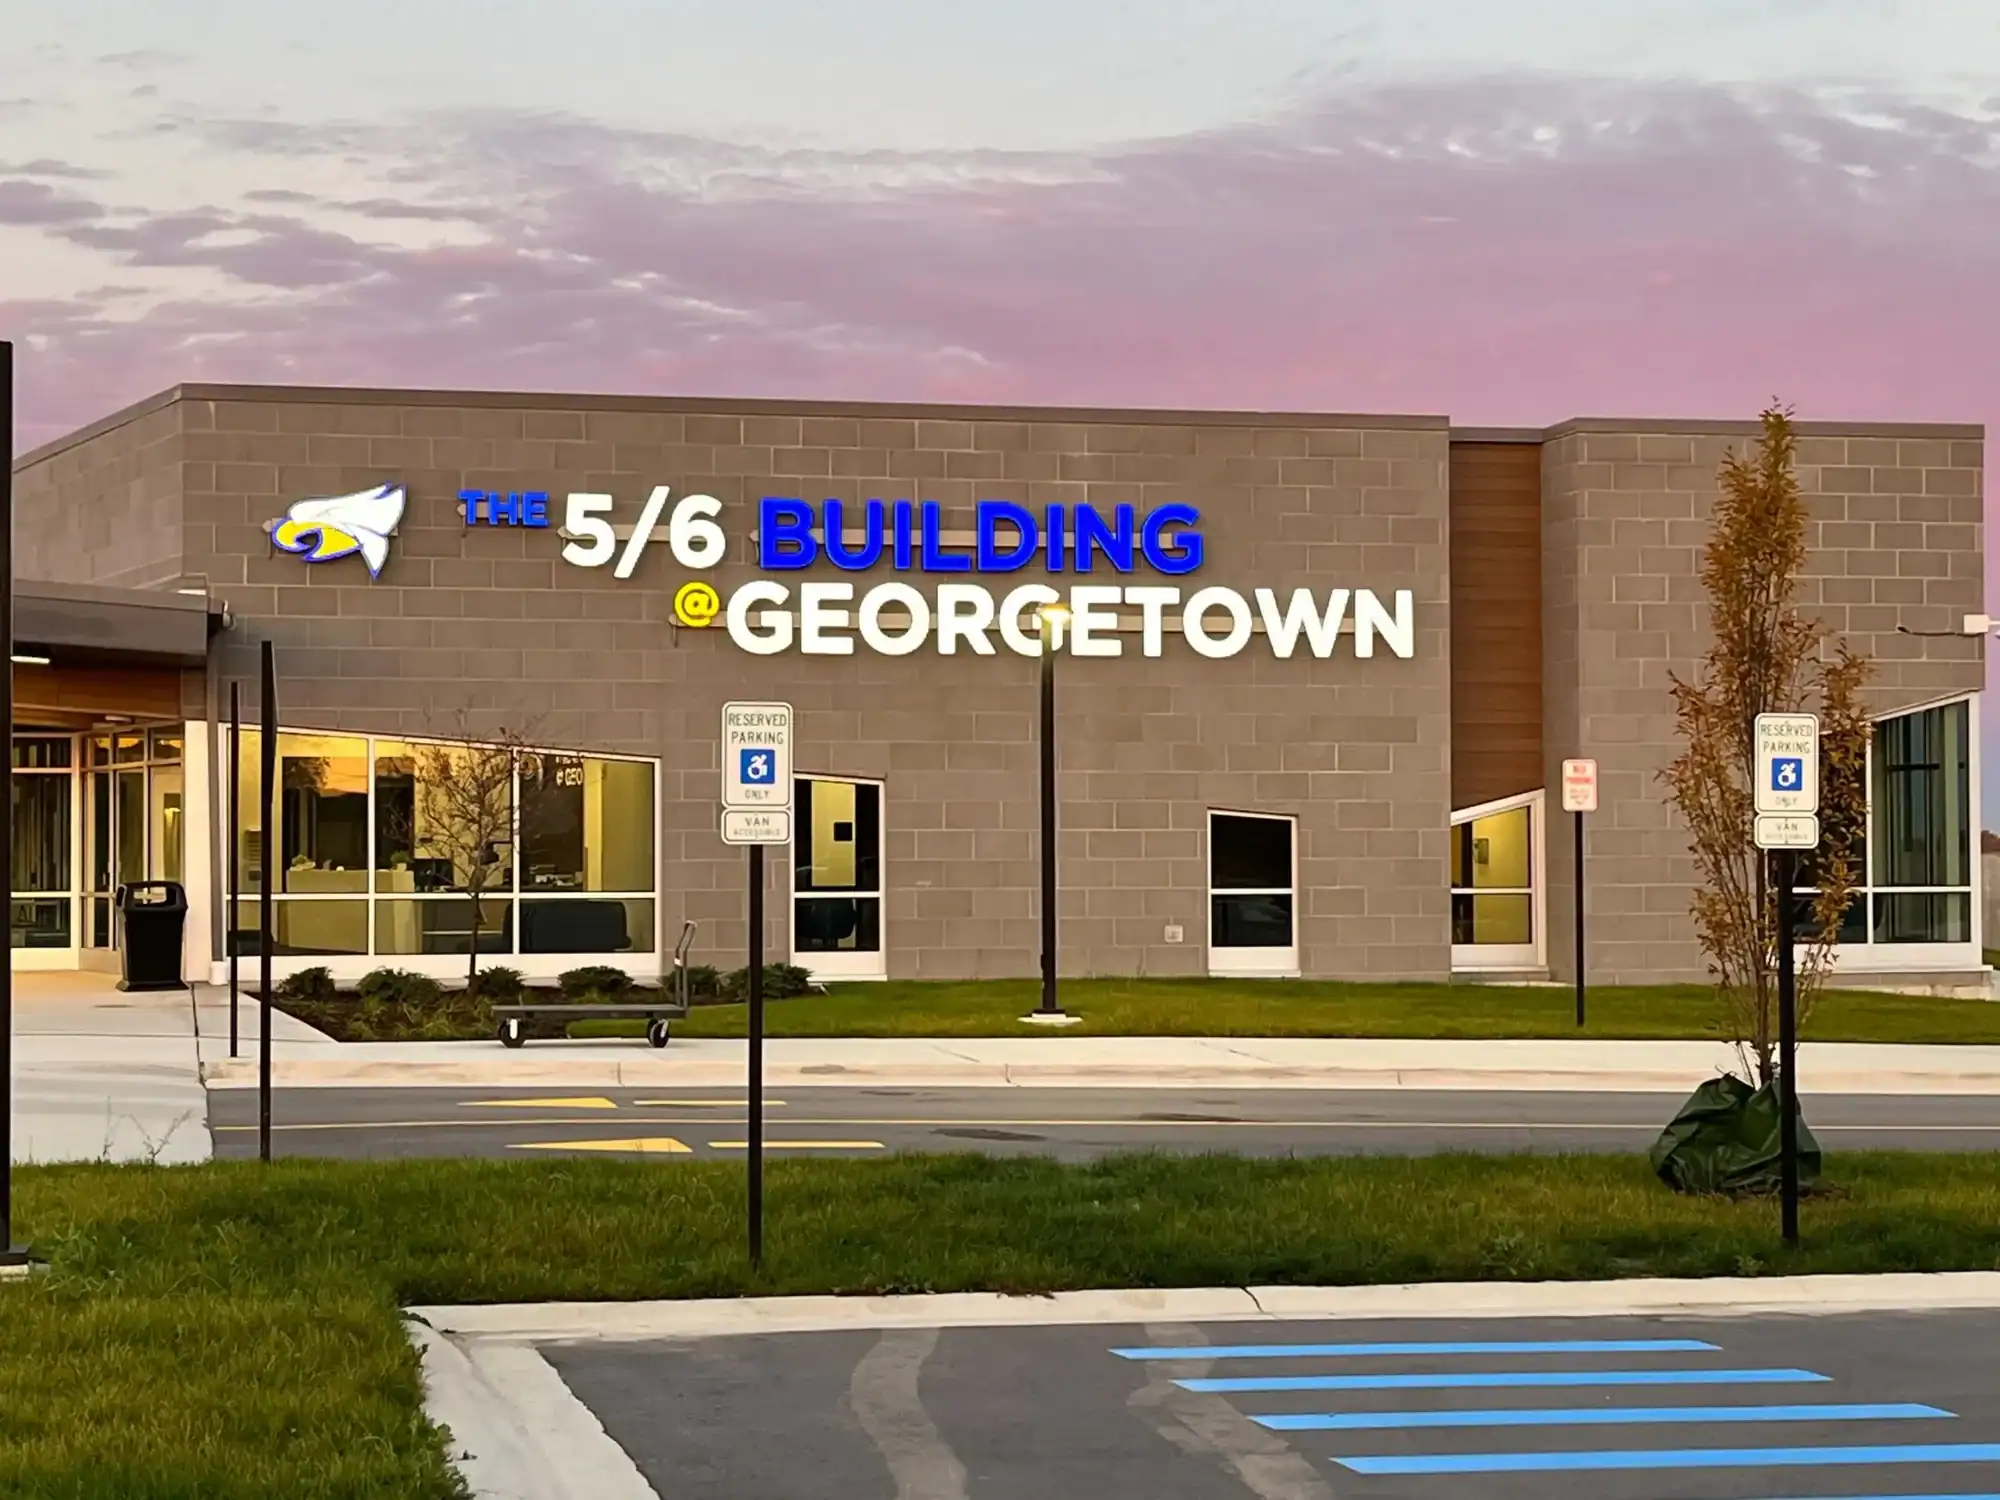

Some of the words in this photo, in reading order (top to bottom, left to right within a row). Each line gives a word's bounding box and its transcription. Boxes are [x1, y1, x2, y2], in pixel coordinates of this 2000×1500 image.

[458, 489, 549, 528] THE
[561, 485, 726, 579] 5/6
[758, 496, 1205, 575] BUILDING
[728, 712, 787, 727] RESERVED
[1760, 724, 1812, 737] RESERVED
[731, 731, 784, 745] PARKING
[1763, 741, 1810, 754] PARKING
[745, 789, 770, 800] ONLY
[744, 816, 770, 827] VAN
[1776, 822, 1798, 832] VAN
